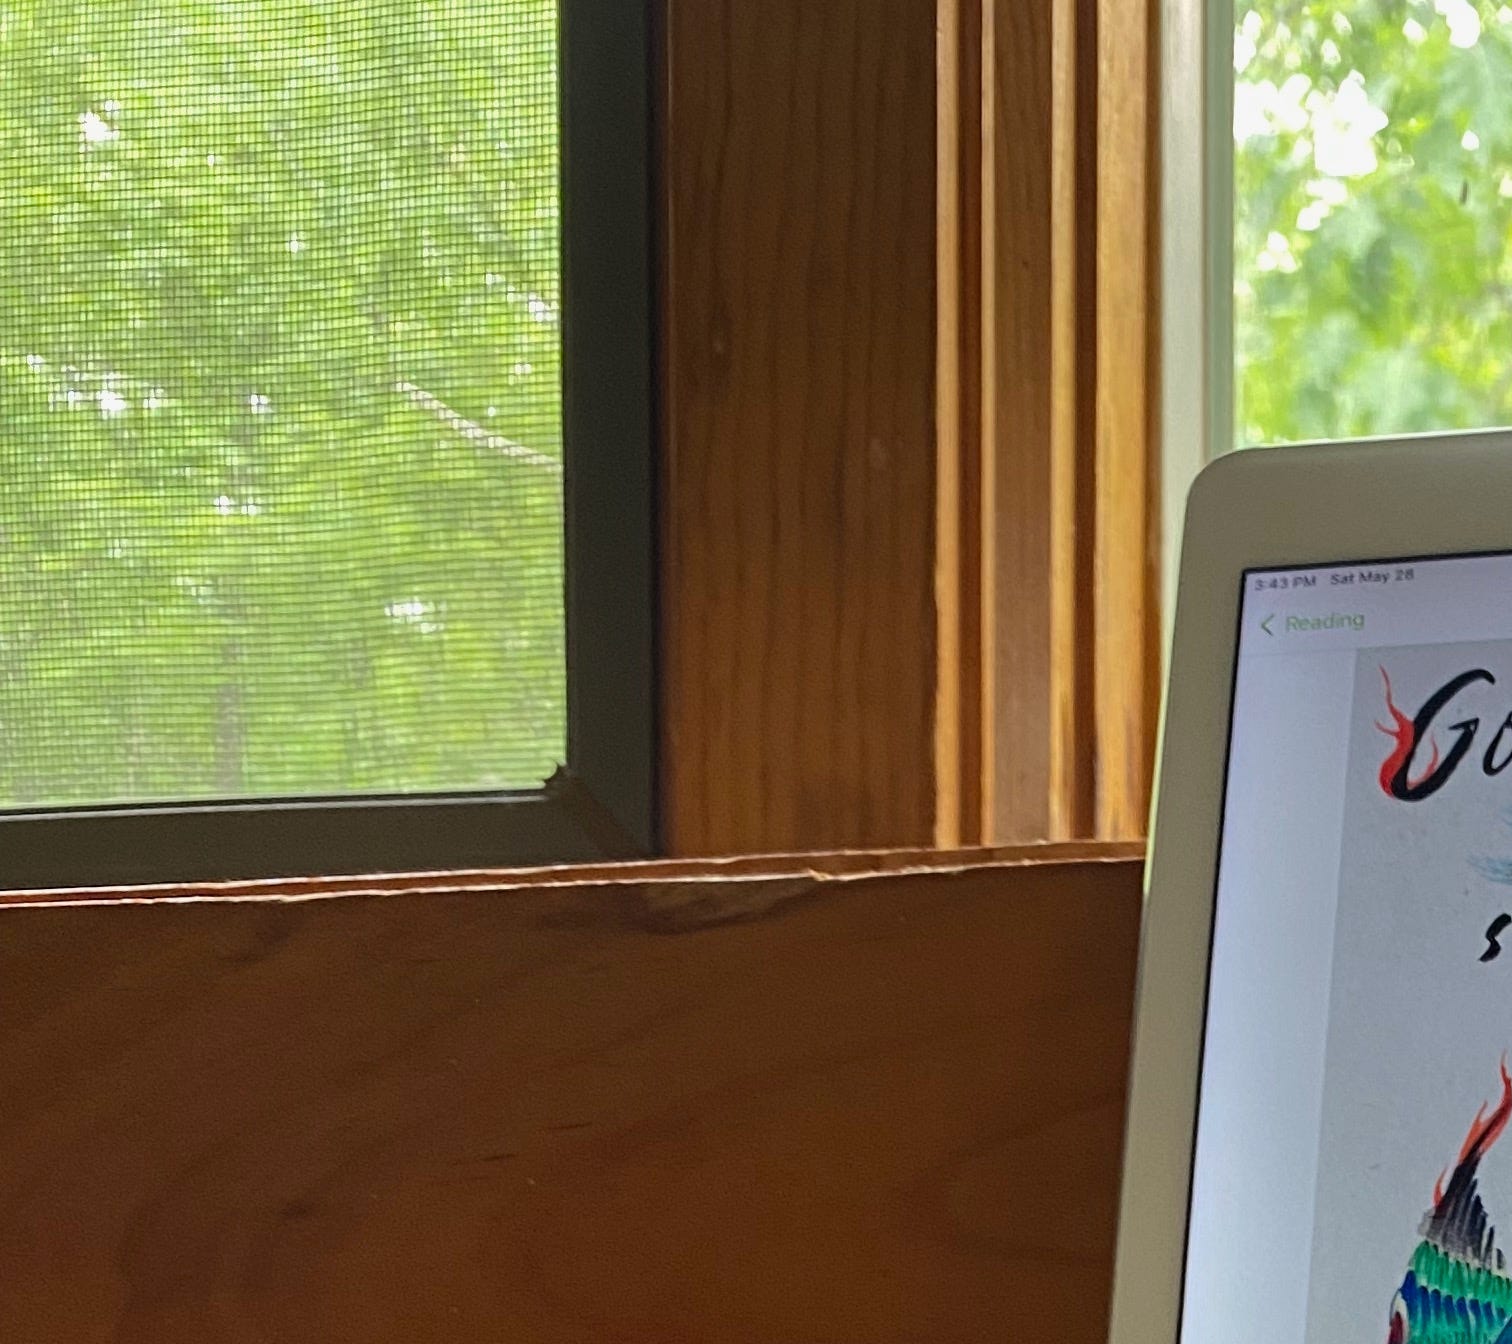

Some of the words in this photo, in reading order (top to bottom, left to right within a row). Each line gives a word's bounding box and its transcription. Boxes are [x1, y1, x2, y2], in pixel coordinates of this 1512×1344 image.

[1293, 576, 1316, 587] PM
[1331, 574, 1355, 585] Sat
[1359, 571, 1390, 584] May
[1286, 612, 1366, 632] Reading
